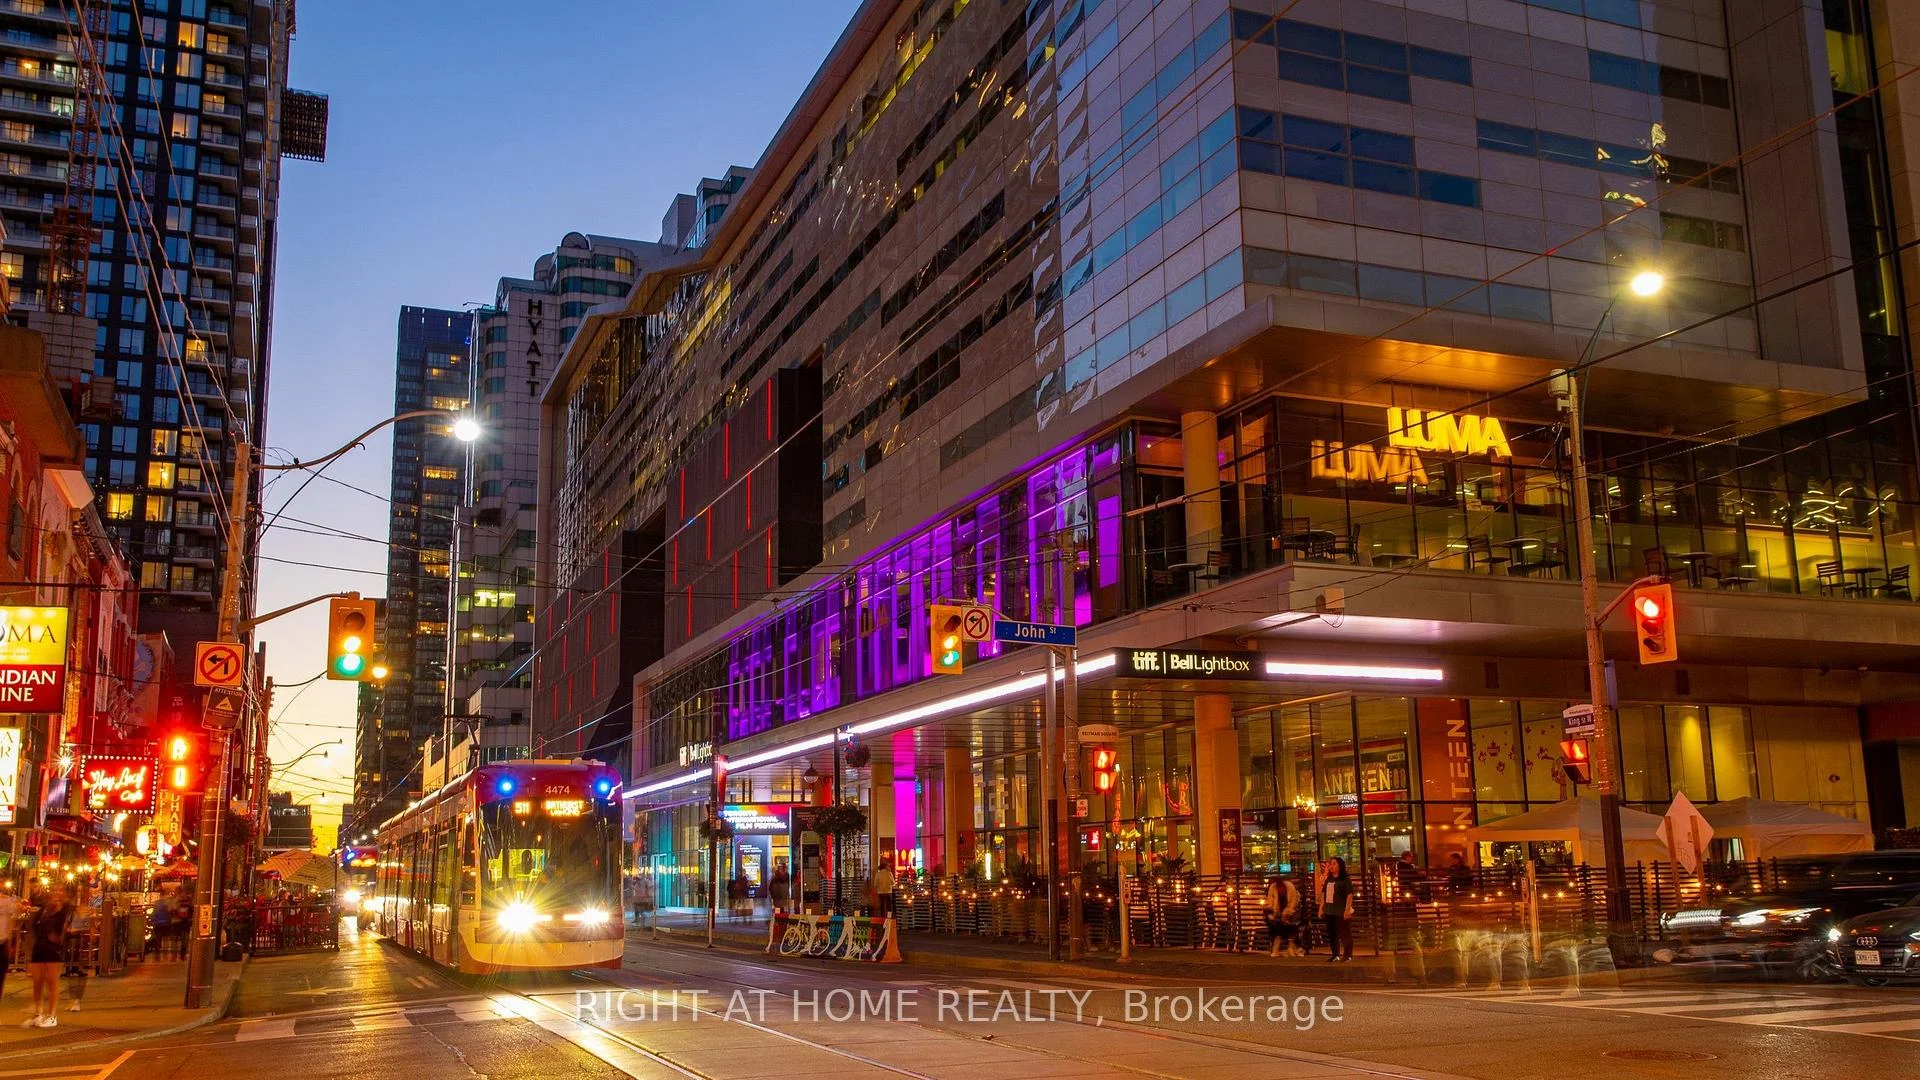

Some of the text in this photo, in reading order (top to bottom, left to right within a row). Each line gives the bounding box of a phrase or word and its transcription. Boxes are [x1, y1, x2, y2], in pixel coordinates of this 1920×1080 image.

[527, 299, 542, 397] HYATT
[1387, 407, 1513, 457] LUMA
[1311, 440, 1429, 485] LUMA
[0, 624, 57, 643] MA
[1015, 624, 1046, 639] John
[545, 785, 570, 795] 4474
[514, 801, 530, 814] 511
